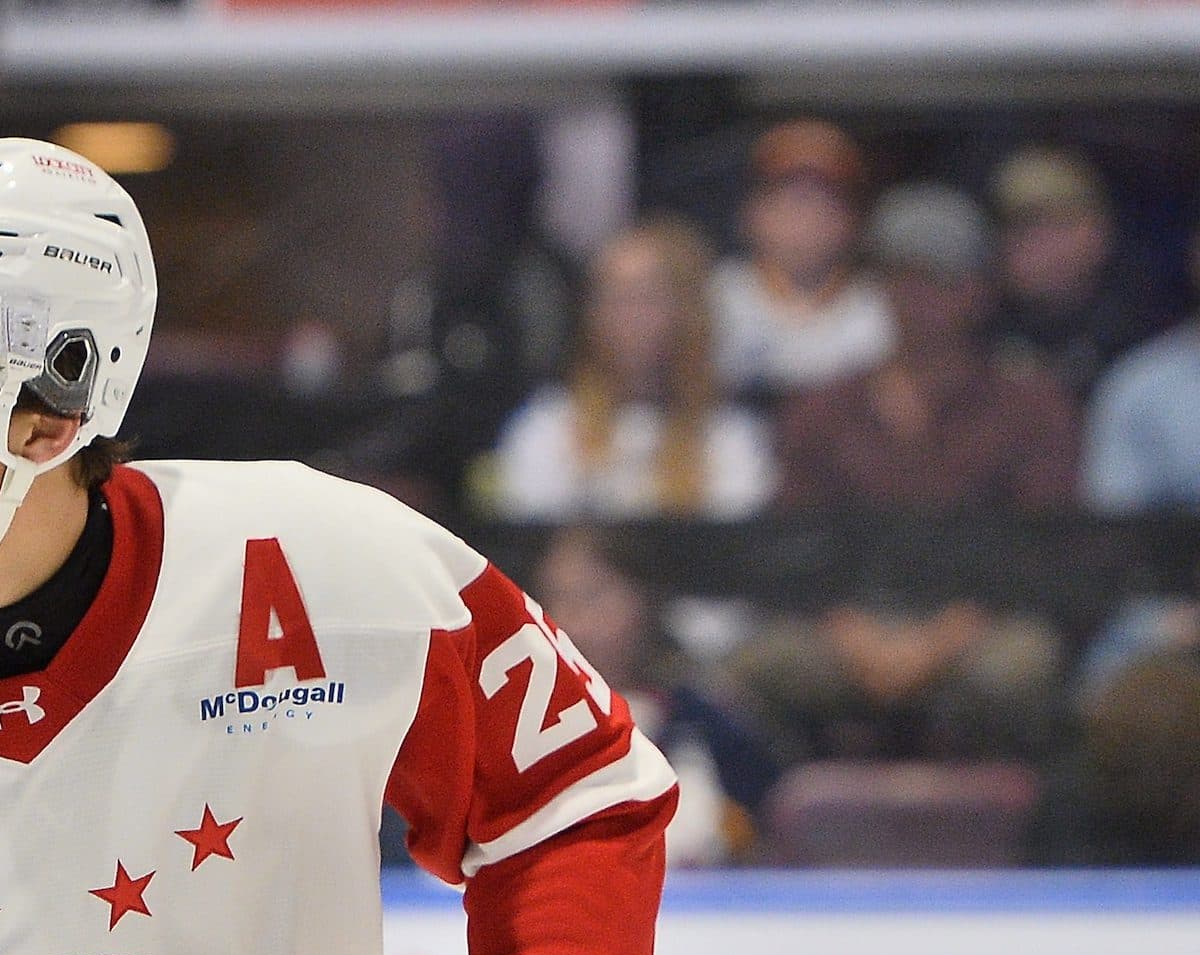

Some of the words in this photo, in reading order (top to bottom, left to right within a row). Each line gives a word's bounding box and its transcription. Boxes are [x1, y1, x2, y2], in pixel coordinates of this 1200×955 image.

[235, 537, 327, 689] A
[200, 682, 346, 721] McDougall
[226, 709, 313, 734] ENEGY
